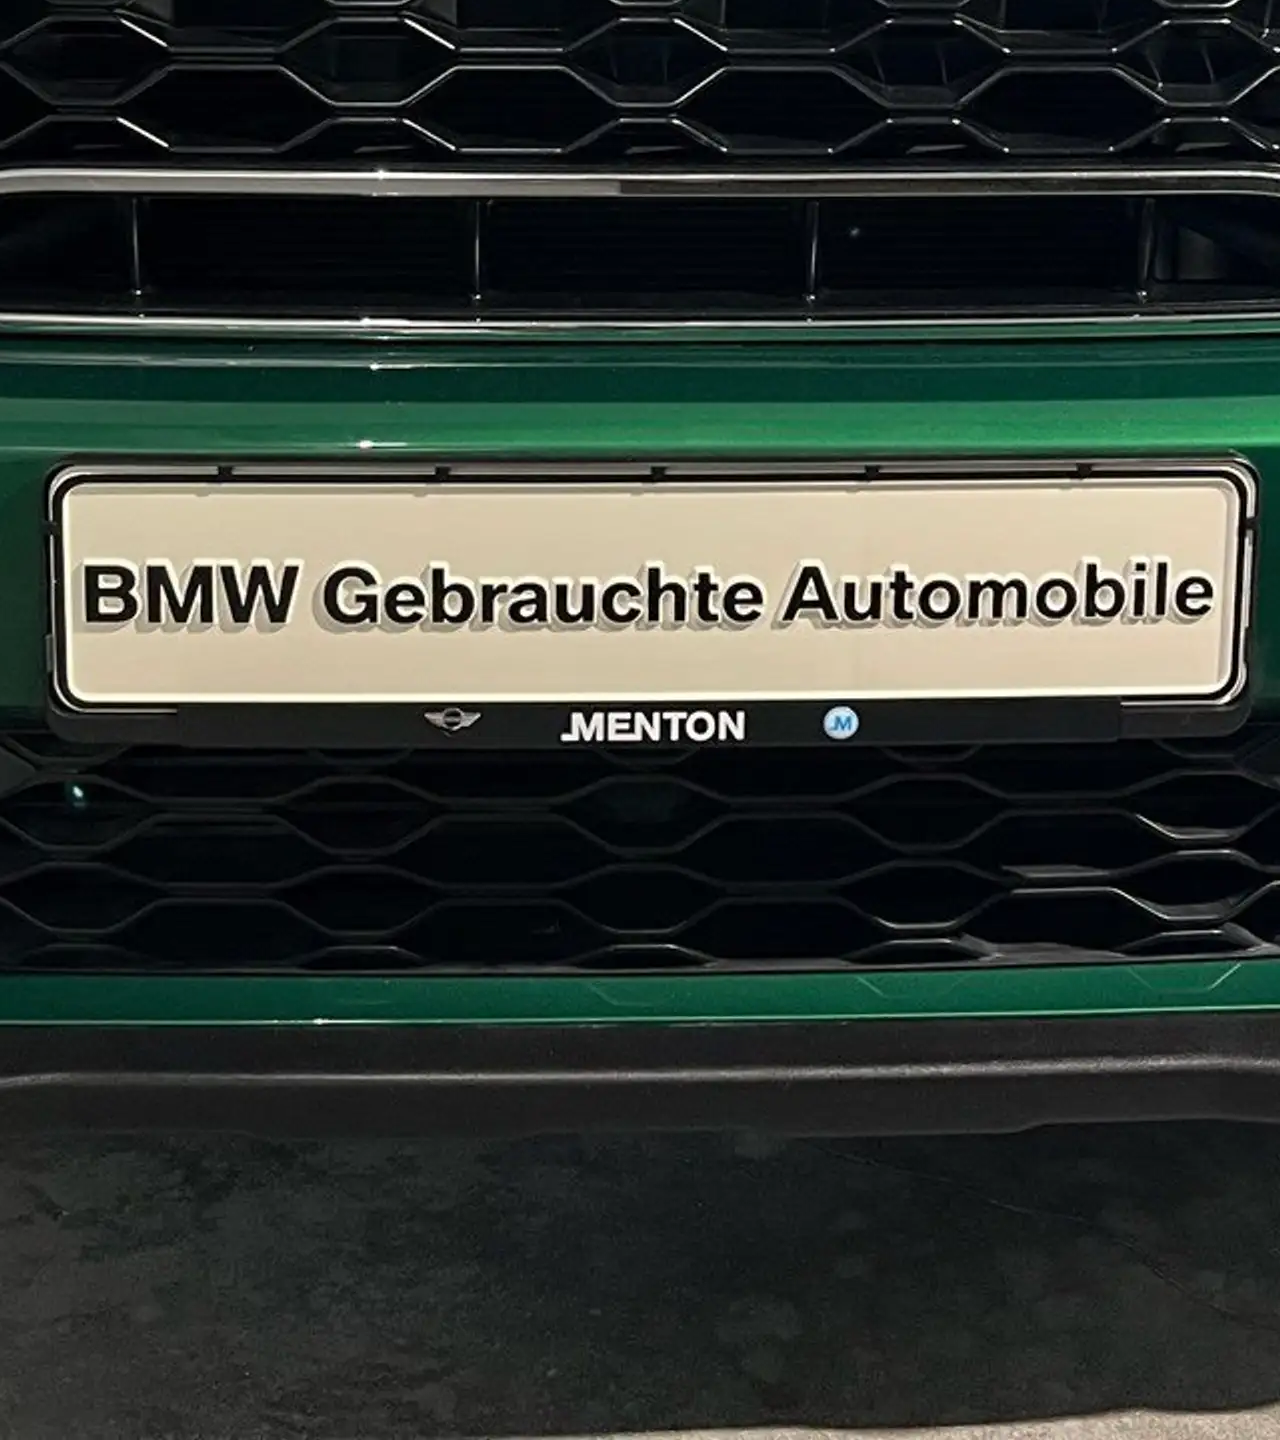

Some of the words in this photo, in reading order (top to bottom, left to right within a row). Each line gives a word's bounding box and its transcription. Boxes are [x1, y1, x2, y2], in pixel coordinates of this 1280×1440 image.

[82, 562, 302, 625] BMW
[323, 565, 764, 625] Gebrauchte
[781, 562, 1214, 622] Automobile
[560, 709, 746, 742] MENTON
